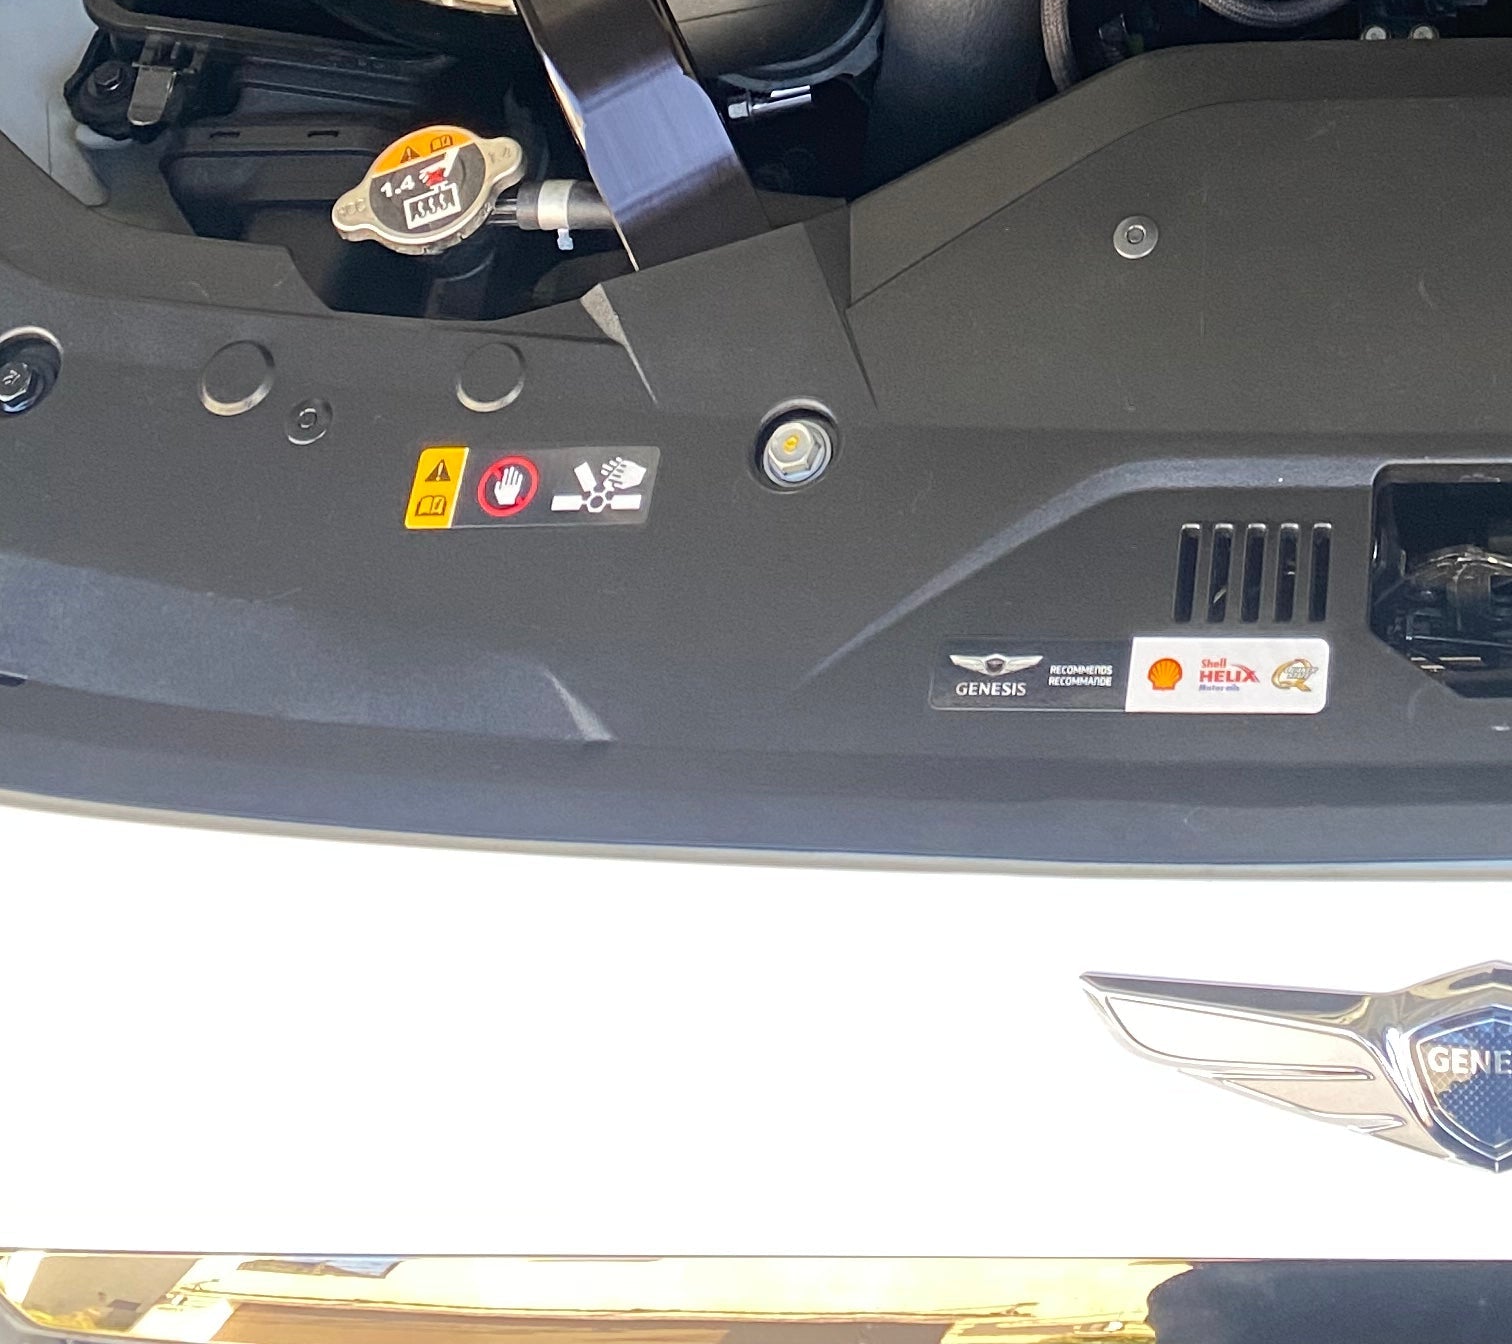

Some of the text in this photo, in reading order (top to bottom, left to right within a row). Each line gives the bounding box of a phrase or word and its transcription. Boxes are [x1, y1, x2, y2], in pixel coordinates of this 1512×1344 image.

[381, 175, 415, 197] 1.4
[1201, 657, 1227, 669] Shell
[1199, 669, 1260, 683] HELIX
[955, 682, 1027, 697] GENESIS
